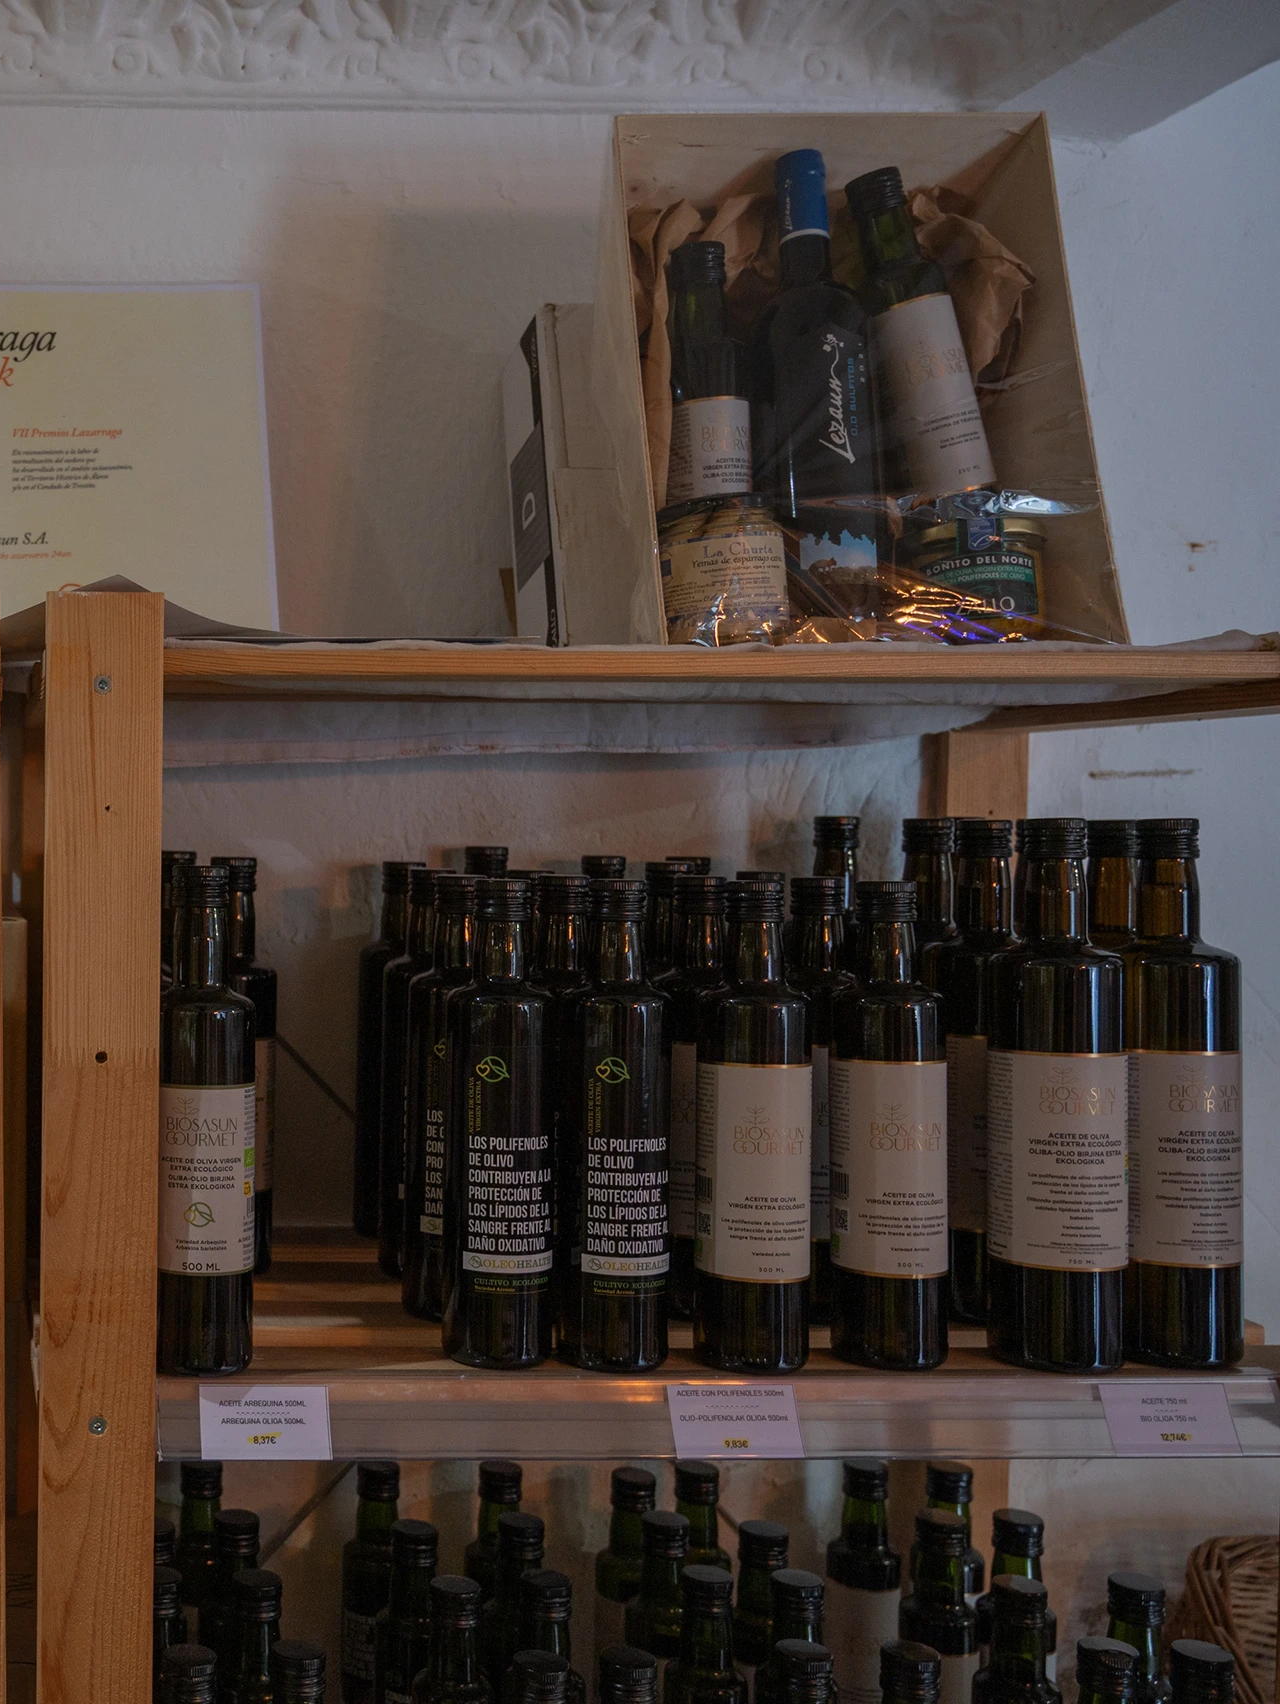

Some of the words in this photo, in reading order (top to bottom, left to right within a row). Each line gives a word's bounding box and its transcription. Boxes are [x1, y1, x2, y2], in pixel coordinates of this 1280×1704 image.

[31, 428, 69, 438] Premios
[71, 428, 123, 440] Lazarraga
[22, 532, 49, 545] S.A.
[703, 545, 724, 559] La
[729, 541, 773, 556] Churta
[925, 558, 970, 576] BONITO
[976, 555, 997, 564] DEL
[1001, 555, 1033, 567] NORTE
[1040, 1086, 1116, 1101] BIOSASUN
[1039, 1100, 1115, 1116] GOURMET
[166, 1117, 238, 1132] BIOSASUN
[165, 1131, 238, 1147] GOURMET
[468, 1135, 487, 1150] LOS
[489, 1135, 549, 1151] POLIFENOLES
[588, 1137, 607, 1151] LOS
[610, 1137, 666, 1152] POLIFENOLES
[1029, 1139, 1058, 1147] VIRGEN
[161, 1156, 184, 1164] ACEITE
[185, 1157, 195, 1165] DE
[195, 1157, 218, 1165] OLIVA
[219, 1156, 242, 1165] VIRGEN
[468, 1152, 481, 1166] DE
[483, 1153, 514, 1168] OLIVO
[588, 1154, 601, 1167] DE
[604, 1155, 634, 1169] OLIVO
[468, 1169, 537, 1185] CONTRIBUYEN
[537, 1170, 543, 1182] A
[544, 1168, 551, 1182] LA
[468, 1185, 530, 1201] PROTECCIÓN
[532, 1186, 542, 1200] DE
[587, 1187, 649, 1203] PROTECCIÓN
[468, 1202, 487, 1216] LOS
[489, 1202, 528, 1218] LÍPIDOS
[530, 1204, 540, 1218] DE
[541, 1202, 550, 1215] LA
[468, 1219, 508, 1235] SANGRE
[511, 1220, 543, 1235] FRENTE
[587, 1221, 629, 1237] SANGRE
[468, 1235, 495, 1251] DAÑO
[498, 1236, 545, 1252] OXIDATIVO
[587, 1238, 616, 1253] DAÑO
[618, 1238, 663, 1254] OXIDATIVO
[182, 1262, 203, 1271] 500
[206, 1262, 220, 1271] ML
[253, 1436, 277, 1445] 8,37€
[724, 1440, 749, 1449] 9,83€
